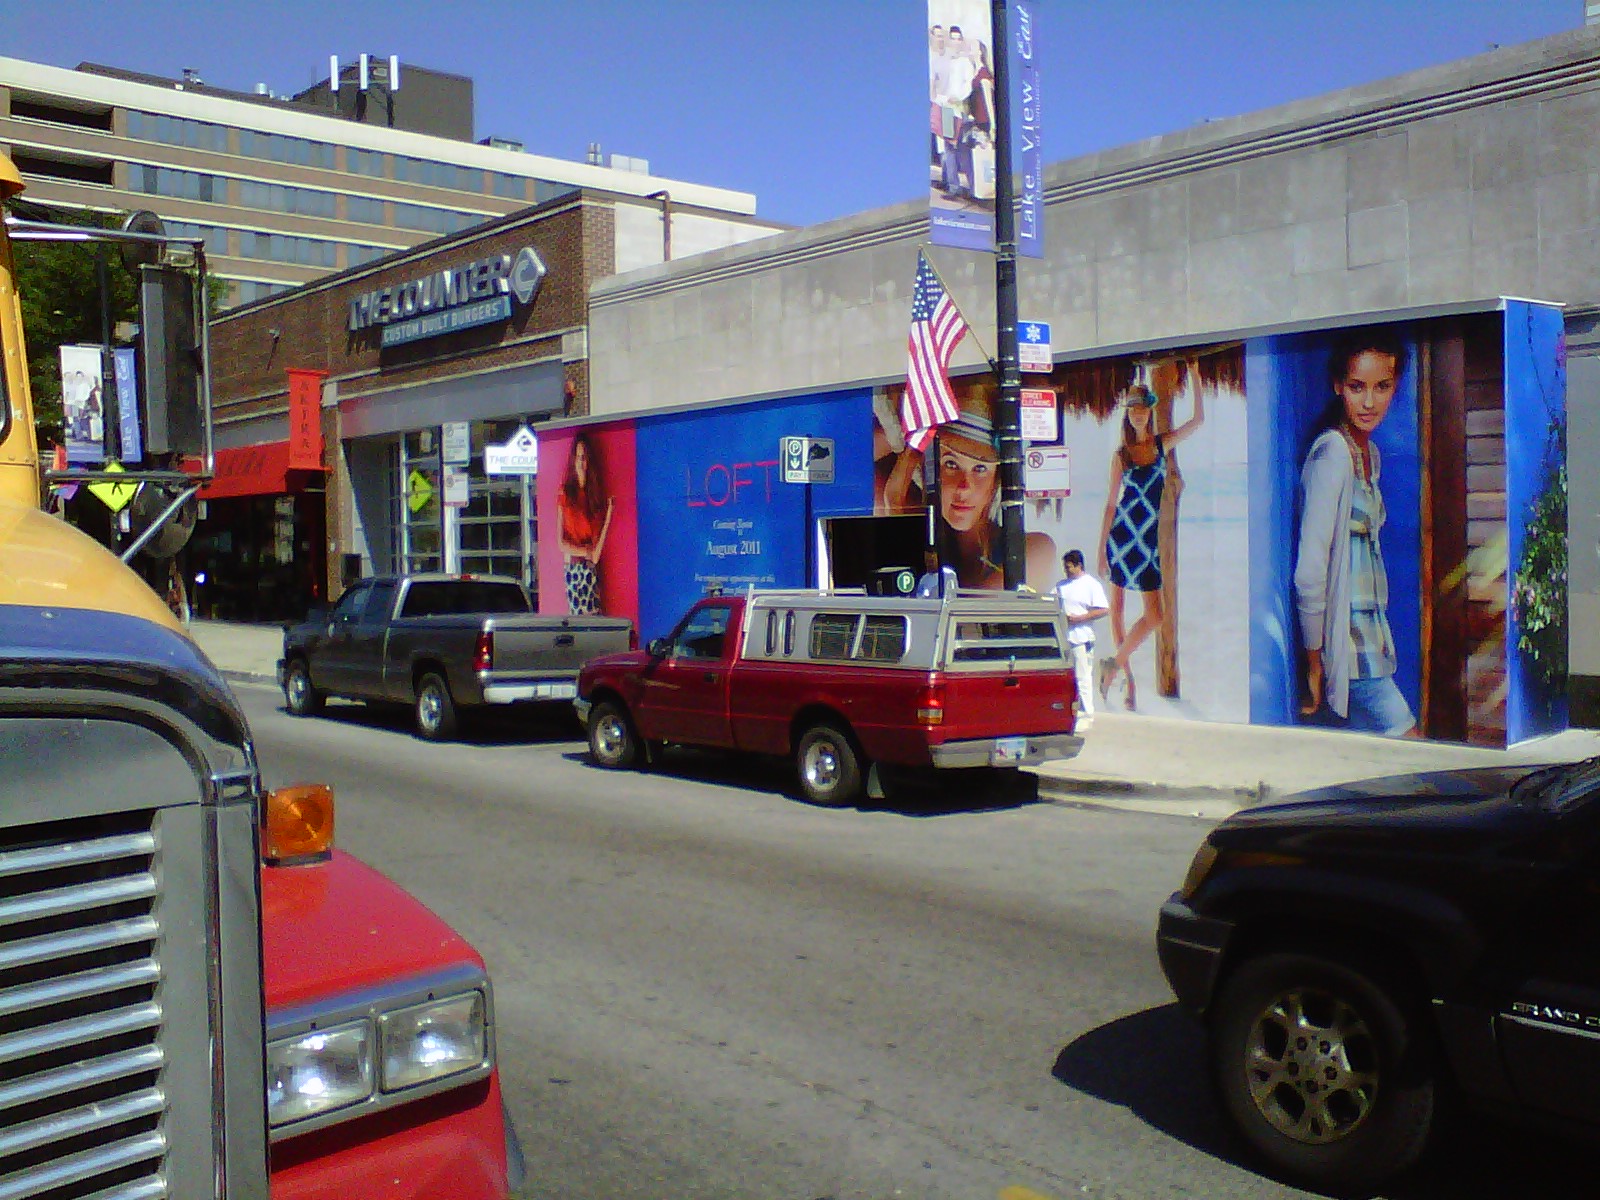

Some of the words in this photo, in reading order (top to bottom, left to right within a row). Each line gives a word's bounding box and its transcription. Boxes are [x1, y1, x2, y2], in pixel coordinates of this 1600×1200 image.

[1021, 80, 1034, 152] View
[1020, 174, 1035, 238] Lake
[390, 255, 511, 318] COUNTER
[383, 319, 420, 343] CUSTOM
[421, 312, 449, 335] BUILT
[451, 302, 499, 327] BURGERS
[488, 456, 510, 465] THE
[687, 459, 780, 507] LOFT
[706, 541, 737, 558] August
[740, 540, 761, 555] 2011
[1512, 1001, 1580, 1023] GRAND
[1585, 1016, 1600, 1027] C
